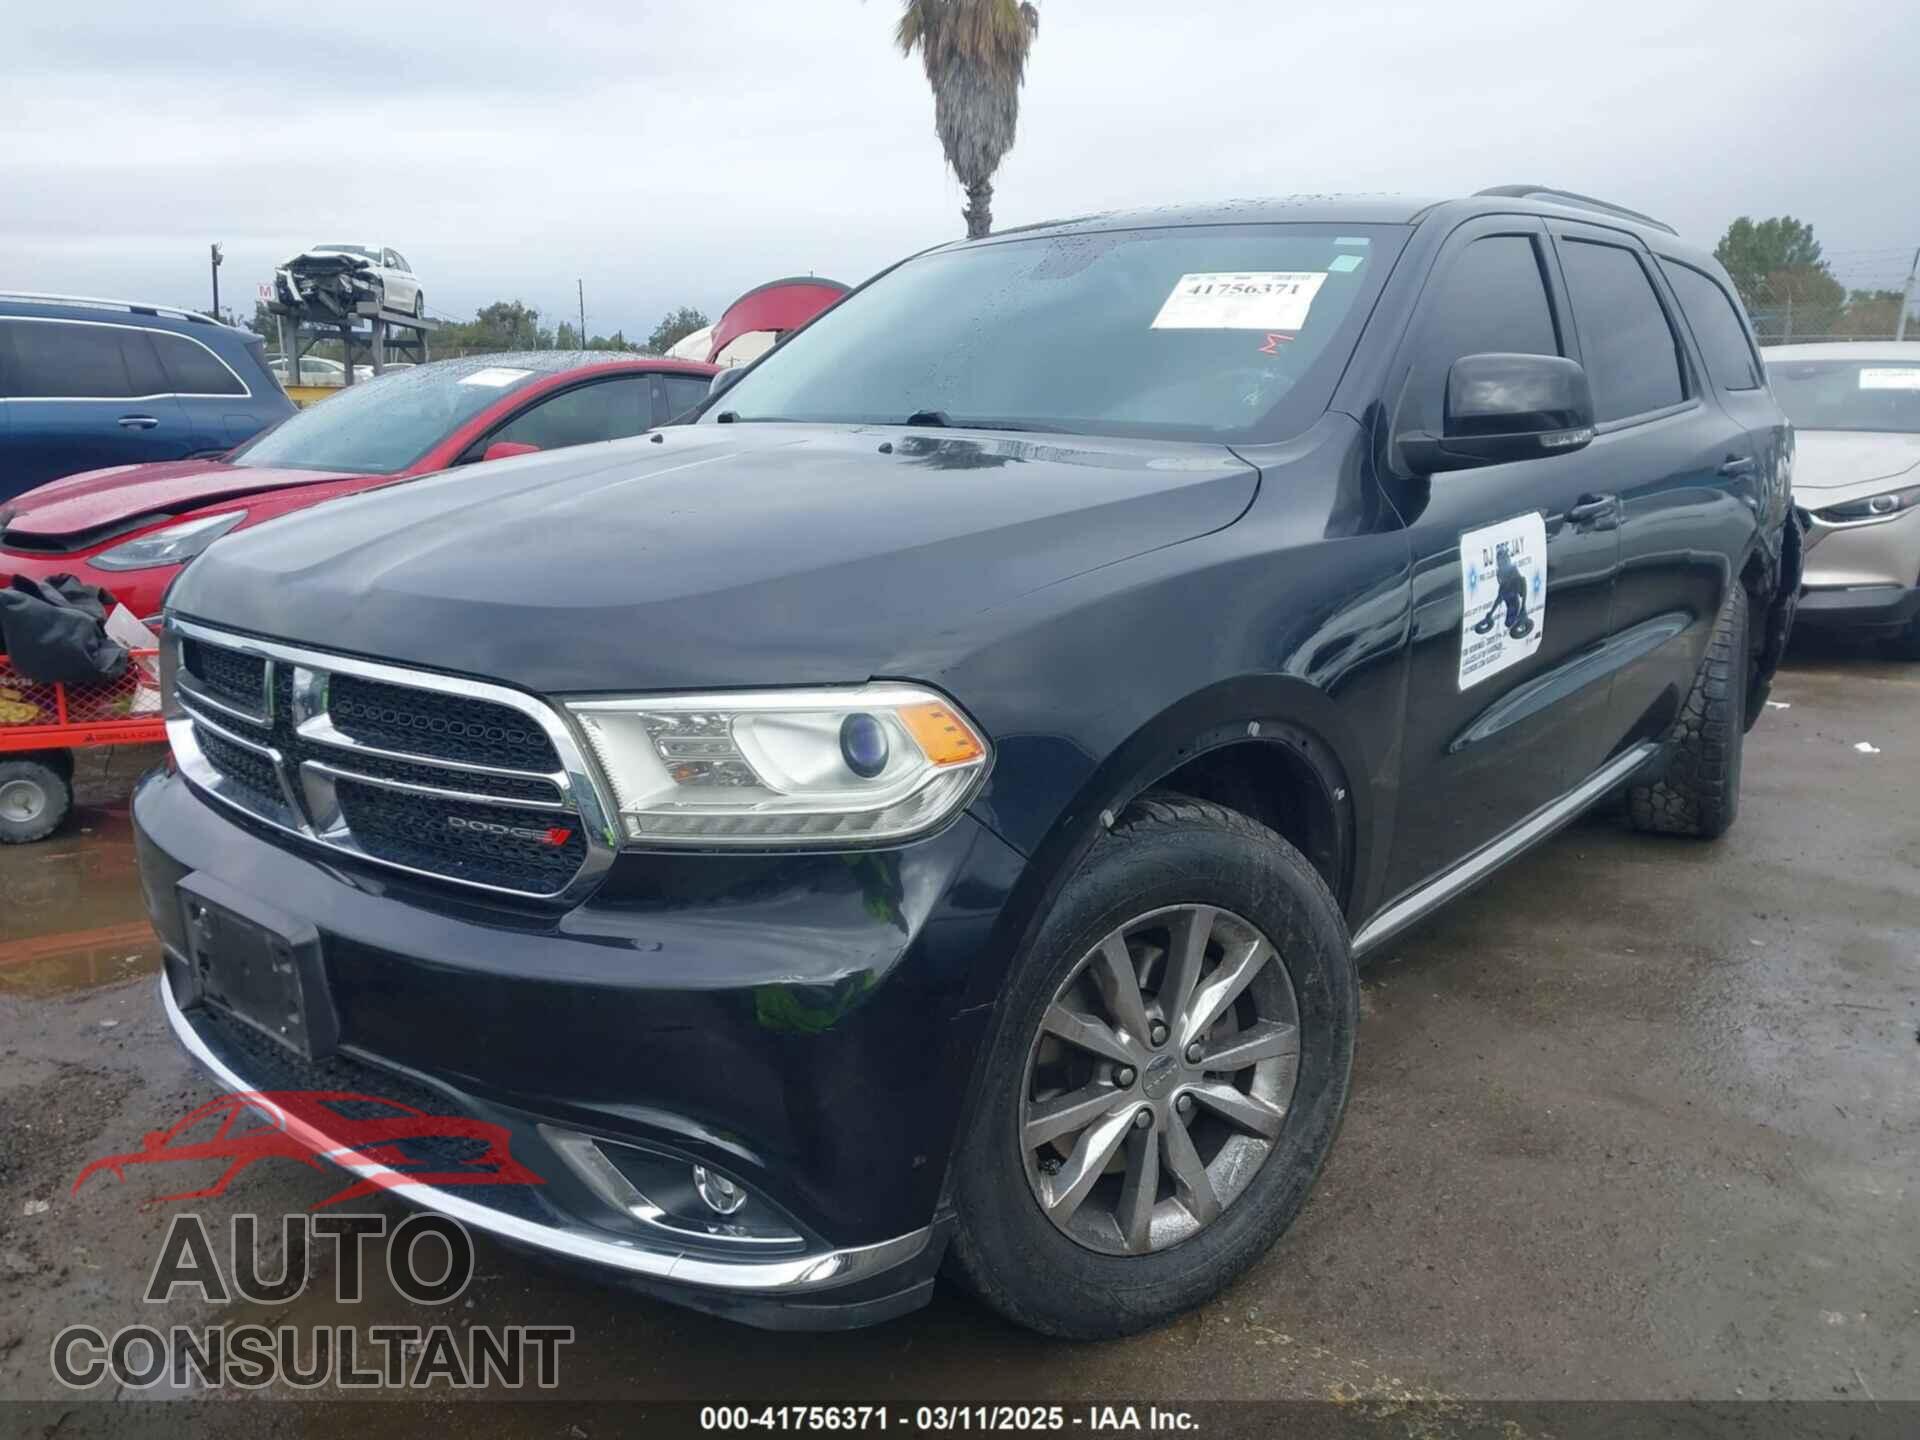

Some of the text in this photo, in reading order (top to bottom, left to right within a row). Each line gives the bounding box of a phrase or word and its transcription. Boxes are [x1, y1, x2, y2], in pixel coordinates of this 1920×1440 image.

[259, 285, 272, 298] M
[1186, 283, 1300, 296] 41756371
[448, 816, 552, 842] DODGE
